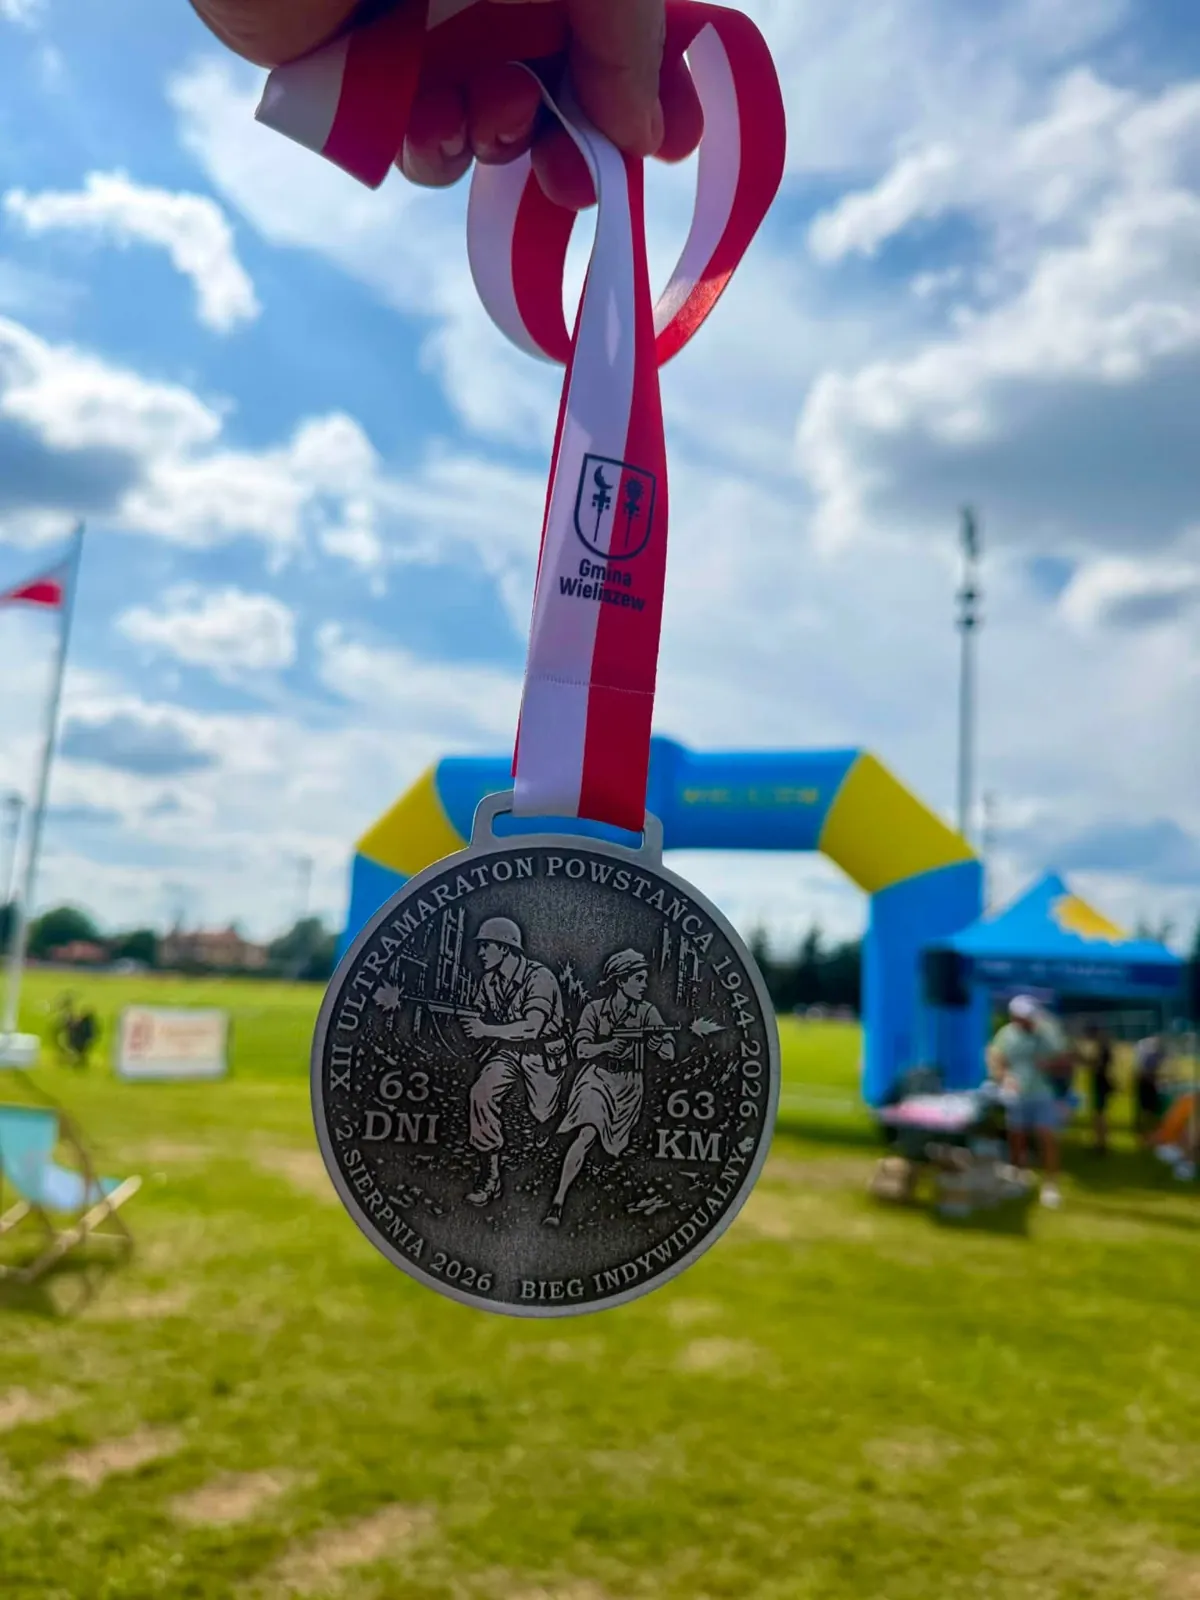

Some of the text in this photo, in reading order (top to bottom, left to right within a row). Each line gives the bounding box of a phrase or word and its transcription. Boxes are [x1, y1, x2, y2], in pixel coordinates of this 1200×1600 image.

[579, 558, 632, 587] Gmina
[560, 576, 645, 611] Wieliszew
[329, 856, 762, 1118] XII ULTRAMARATON POWSTAŃCA 1944-2026
[379, 1070, 430, 1101] 63
[666, 1089, 716, 1120] 63
[362, 1110, 439, 1144] DNI
[654, 1129, 723, 1162] KM
[344, 1149, 426, 1259] SIERPNIA
[430, 1252, 493, 1292] 2026
[521, 1146, 746, 1299] BIEG INDYWIDUALNY
